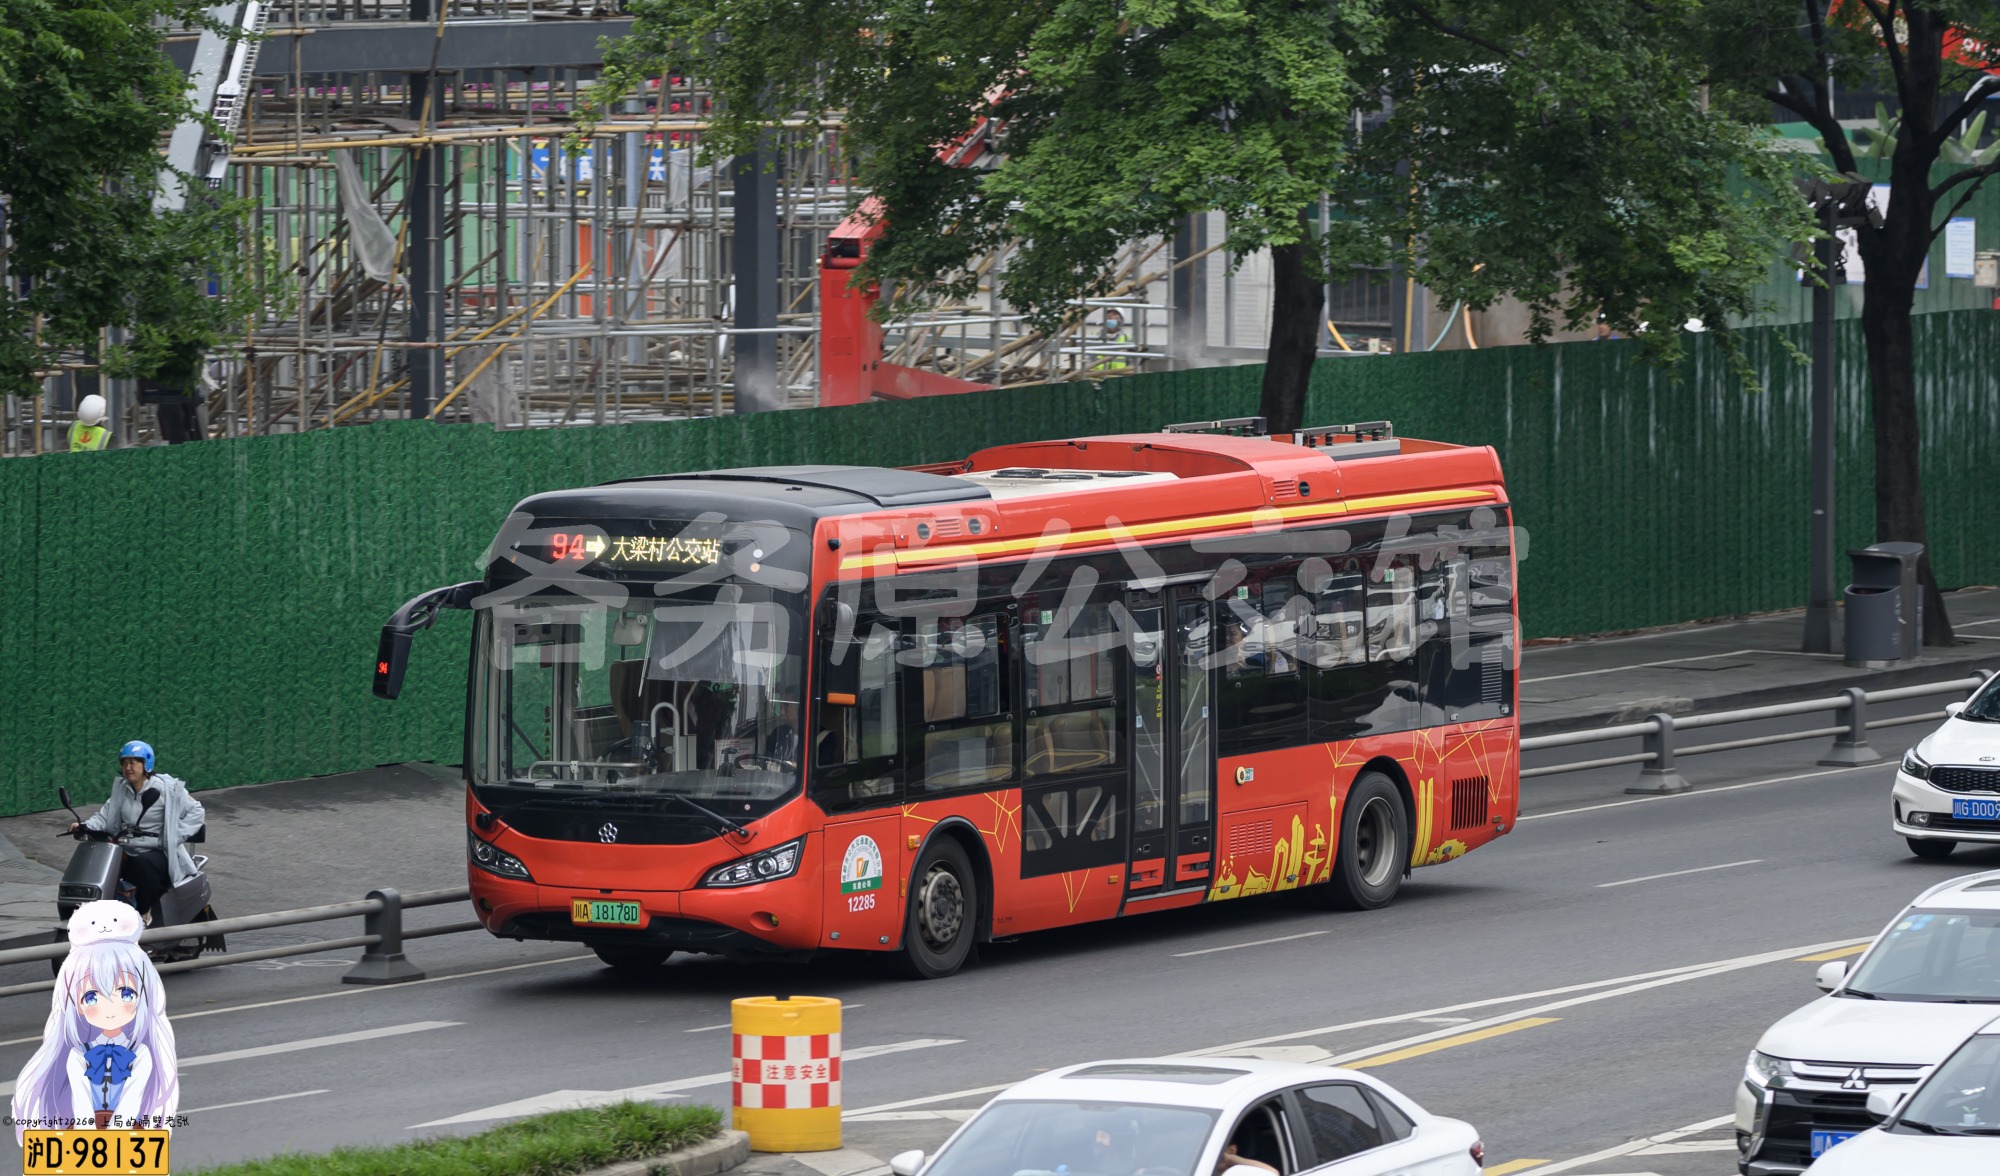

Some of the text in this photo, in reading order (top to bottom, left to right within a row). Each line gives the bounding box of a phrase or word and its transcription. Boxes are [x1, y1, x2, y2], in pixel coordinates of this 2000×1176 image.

[552, 533, 720, 564] 94 大梁村公交站
[378, 661, 388, 675] 94
[847, 894, 875, 913] 12285
[766, 1064, 827, 1080] 注意安全
